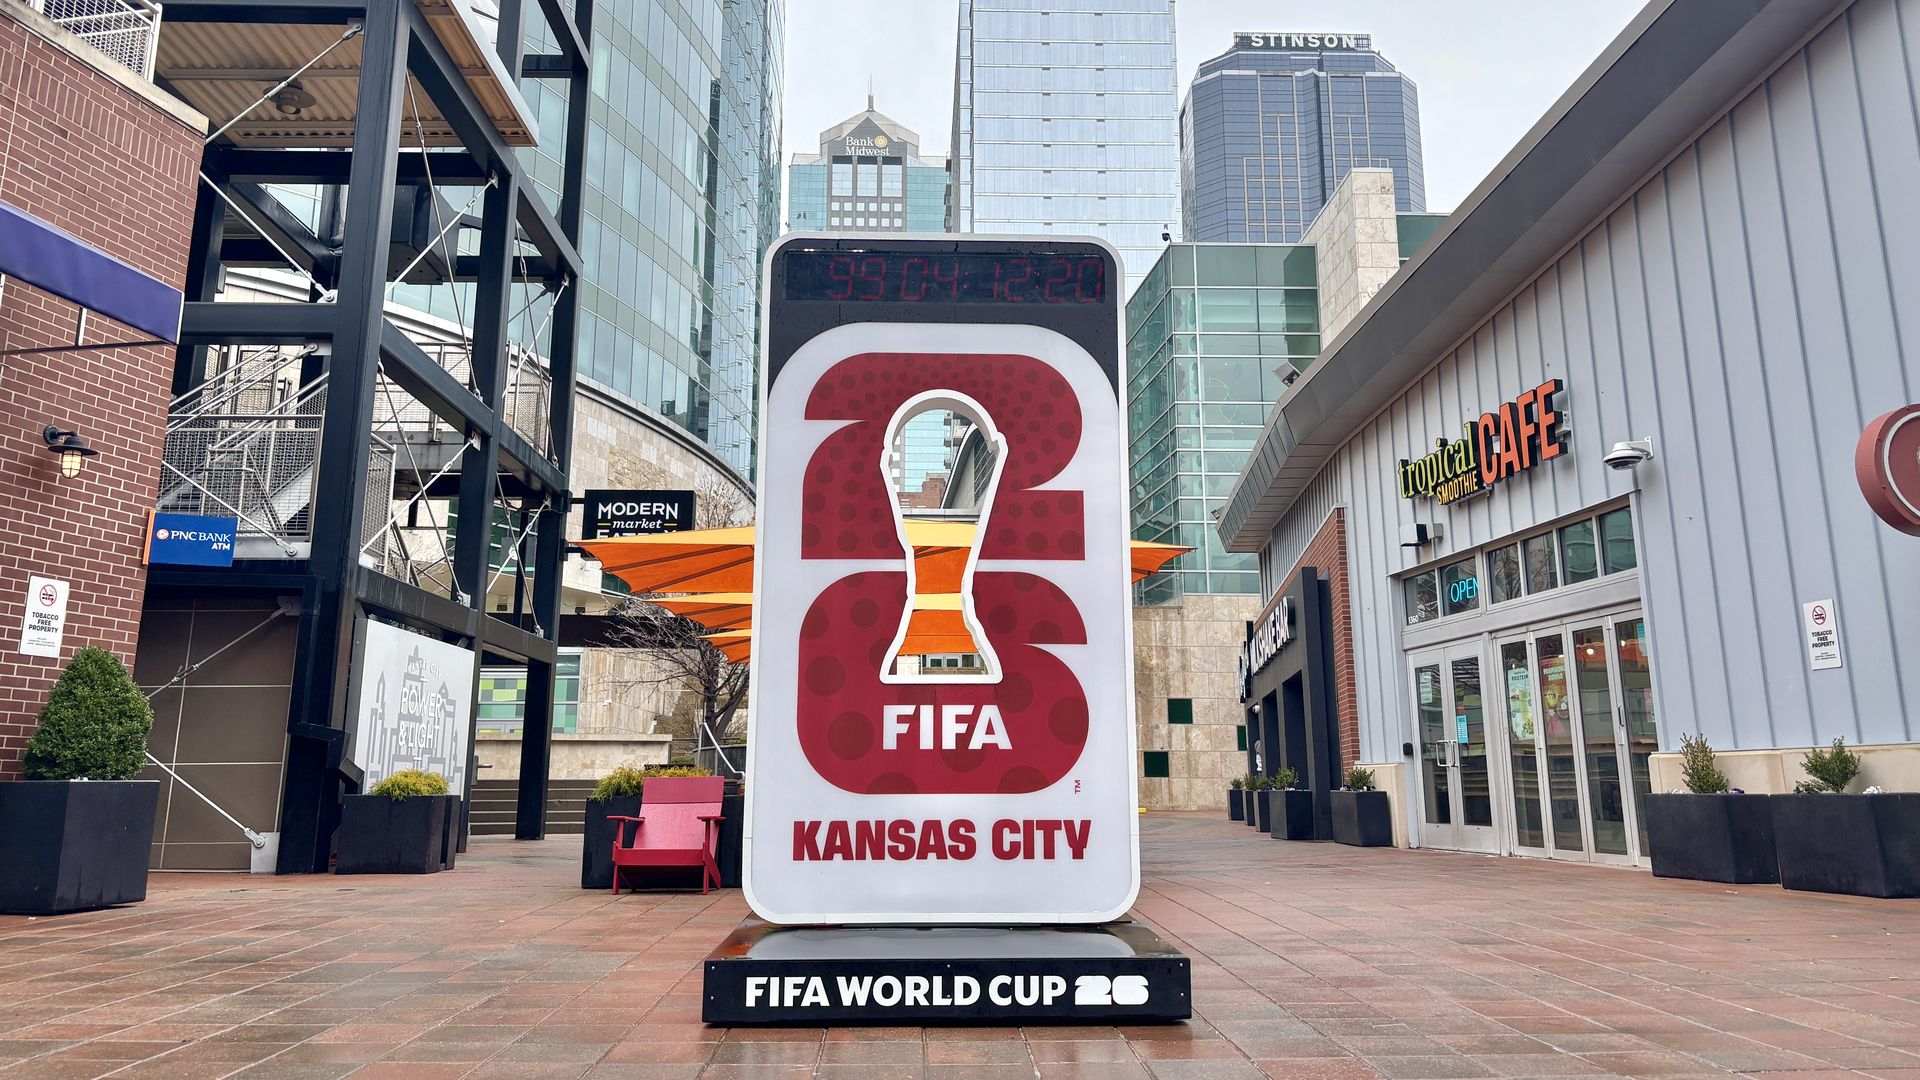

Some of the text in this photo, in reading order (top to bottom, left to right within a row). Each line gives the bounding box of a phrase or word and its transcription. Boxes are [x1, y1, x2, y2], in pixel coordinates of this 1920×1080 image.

[1251, 33, 1356, 48] STINSON
[845, 136, 875, 147] Bank
[845, 146, 890, 156] Midwest
[1398, 379, 1561, 499] tropical CAFE
[1436, 470, 1479, 506] SMOOTHIE
[597, 502, 679, 520] MODERN
[612, 519, 662, 529] market
[170, 530, 231, 543] PNC BANK
[211, 542, 231, 551] ATM
[1451, 576, 1479, 603] OPEN
[32, 611, 59, 621] TOBACCO
[1275, 596, 1290, 651] BAR
[28, 624, 59, 634] PROPERTY
[1811, 629, 1833, 637] TOBACCO
[1812, 640, 1835, 648] PROPERTY
[400, 687, 442, 719] POWER
[882, 704, 1013, 750] FIFA
[408, 722, 440, 749] LIGHT
[792, 818, 1092, 861] KANSAS CITY
[745, 975, 1149, 1007] FIFA WORLD CUP 26
